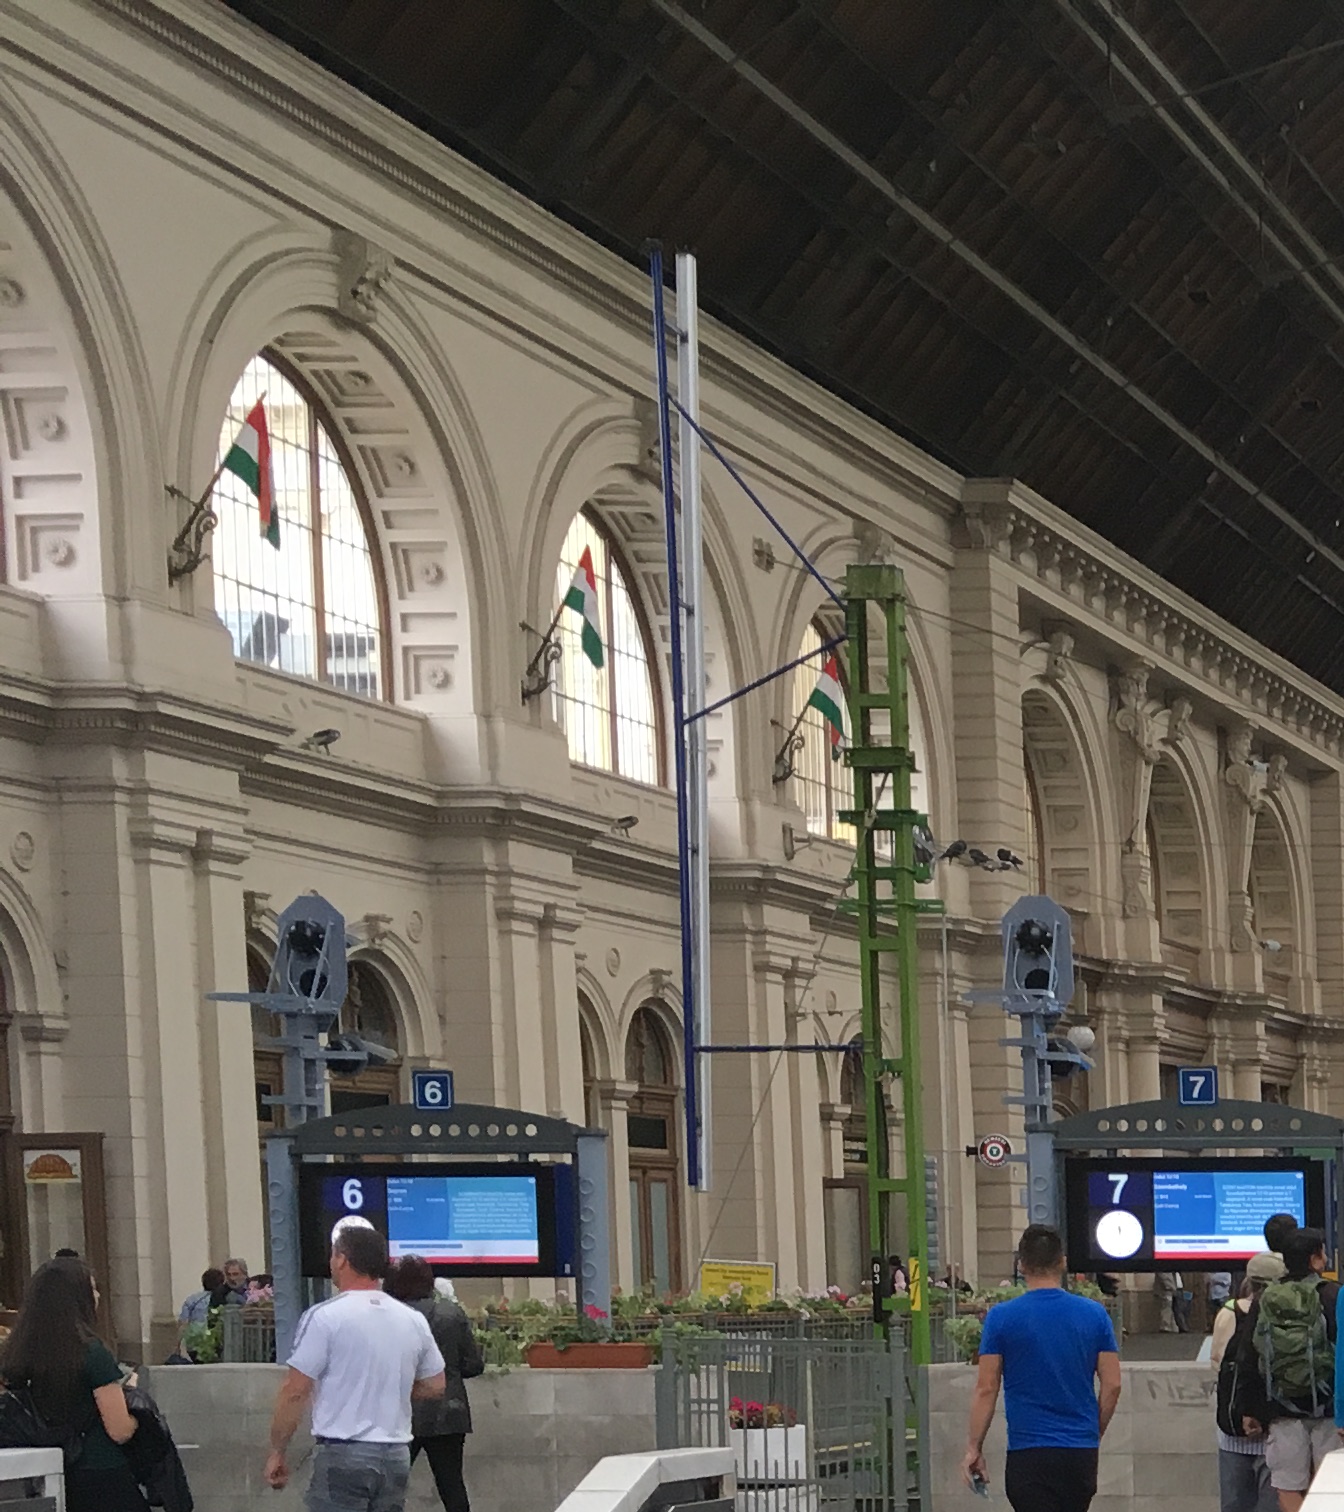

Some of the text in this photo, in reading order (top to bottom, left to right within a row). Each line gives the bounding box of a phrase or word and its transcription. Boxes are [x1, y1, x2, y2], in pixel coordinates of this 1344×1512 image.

[425, 1081, 442, 1103] 6
[1189, 1076, 1205, 1098] 7
[343, 1179, 363, 1209] 6
[1108, 1174, 1128, 1203] 7
